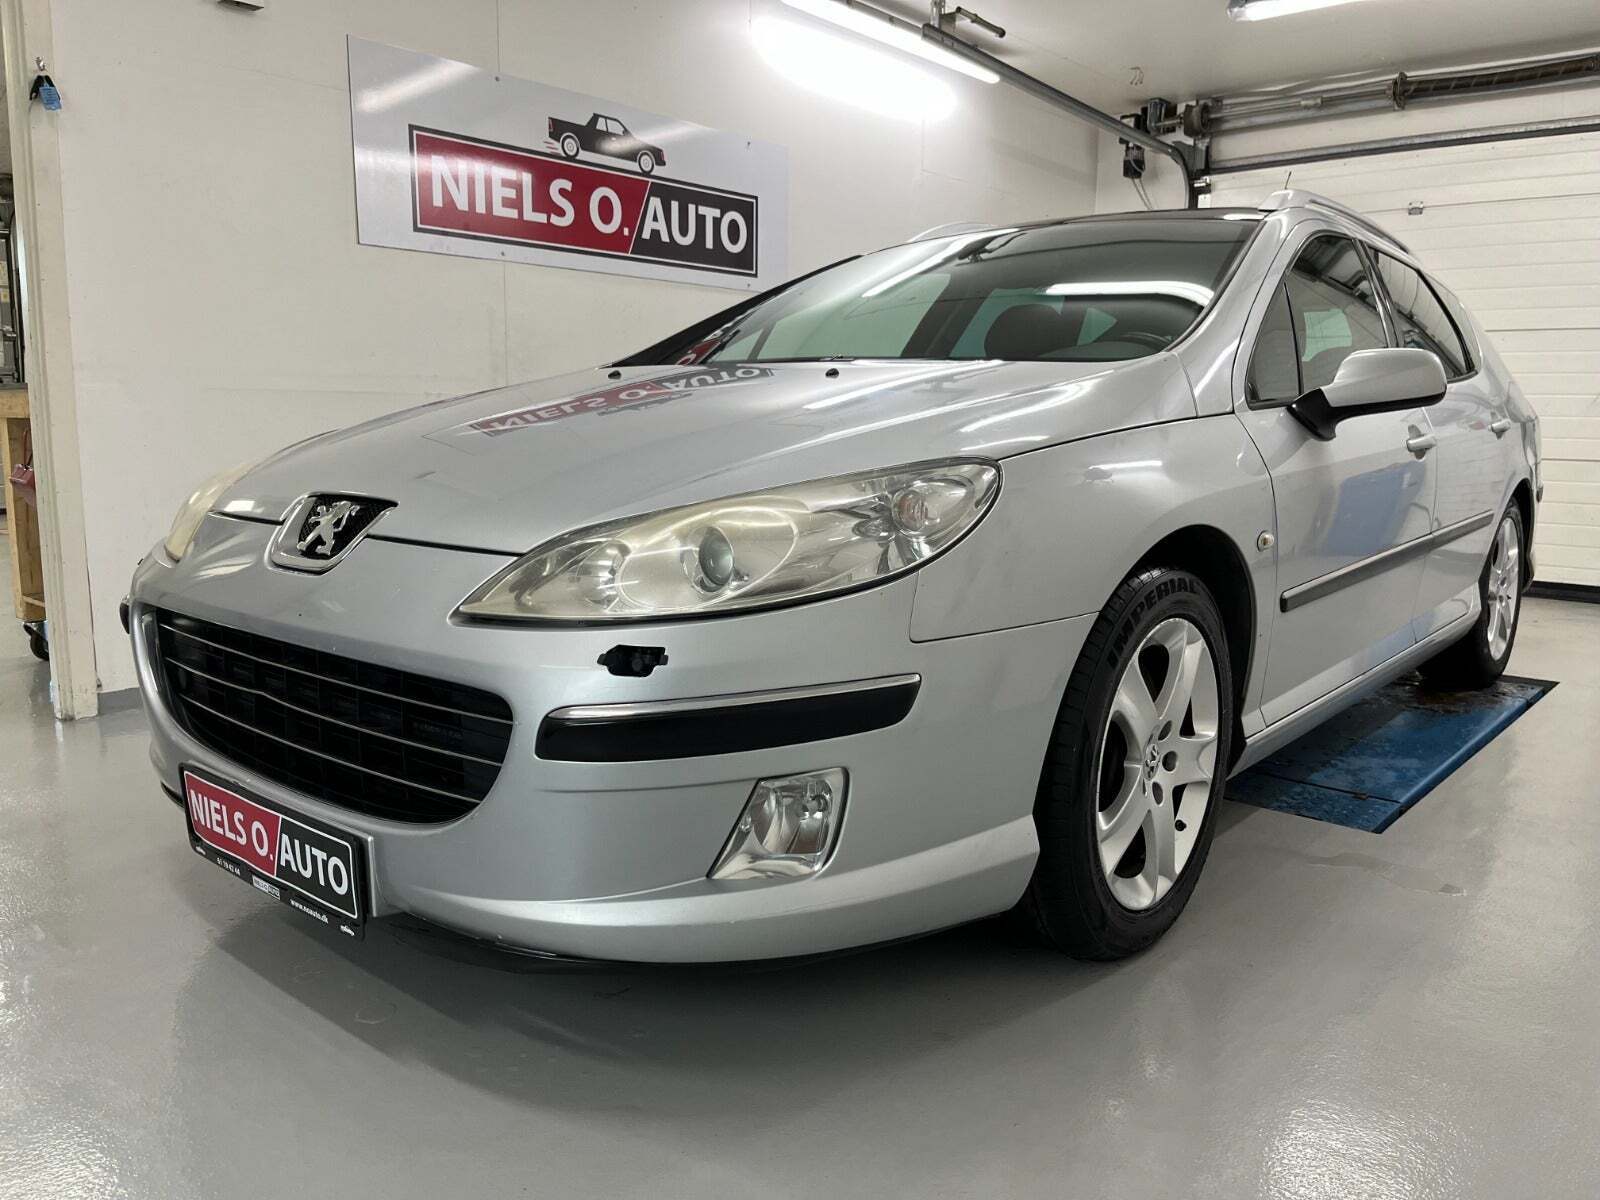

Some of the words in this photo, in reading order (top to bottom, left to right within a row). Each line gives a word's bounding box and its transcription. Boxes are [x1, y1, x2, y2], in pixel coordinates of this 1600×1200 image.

[430, 155, 575, 227] NIELS
[588, 186, 630, 237] O.
[640, 196, 748, 254] AUTO
[1106, 576, 1201, 671] IMPERIAL
[188, 788, 247, 846] NIELS
[251, 819, 275, 861] O.
[279, 833, 349, 896] AUTO
